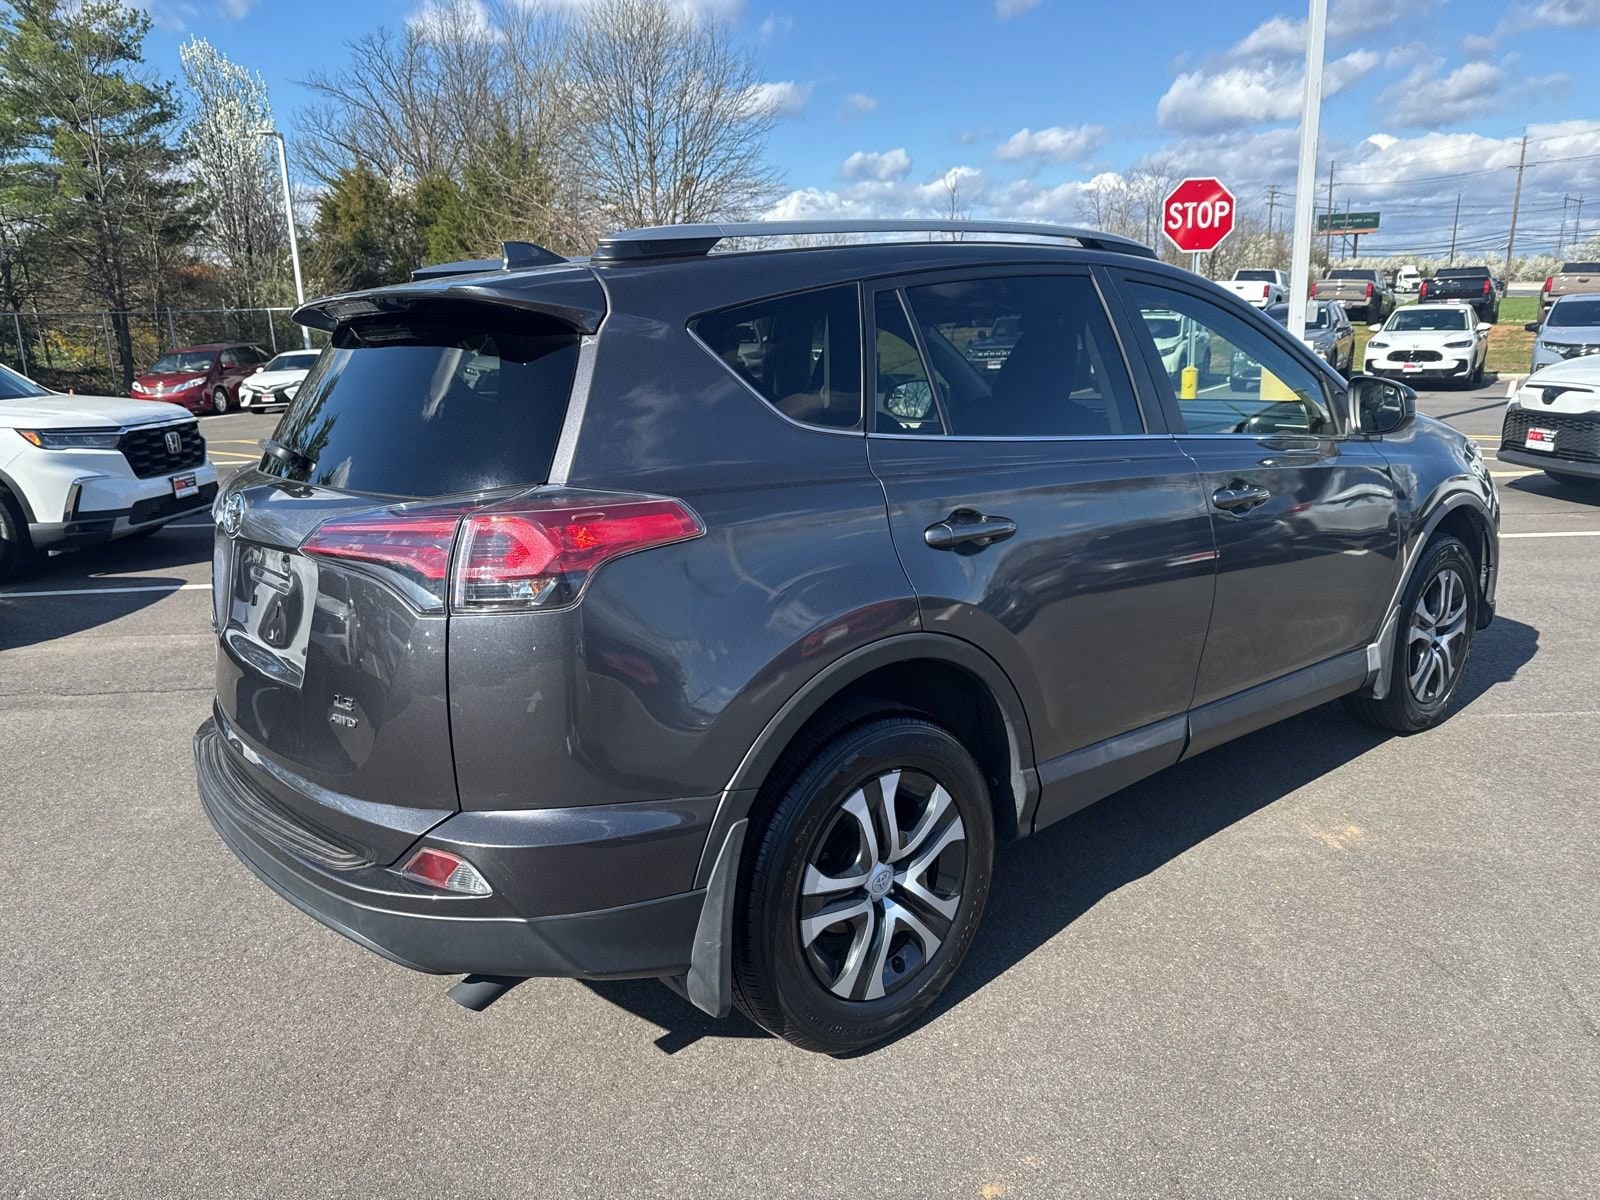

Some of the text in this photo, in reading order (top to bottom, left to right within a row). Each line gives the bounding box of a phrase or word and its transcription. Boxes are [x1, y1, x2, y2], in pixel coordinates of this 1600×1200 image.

[1167, 200, 1230, 230] STOP
[333, 694, 354, 711] LE
[330, 713, 359, 728] AWD
